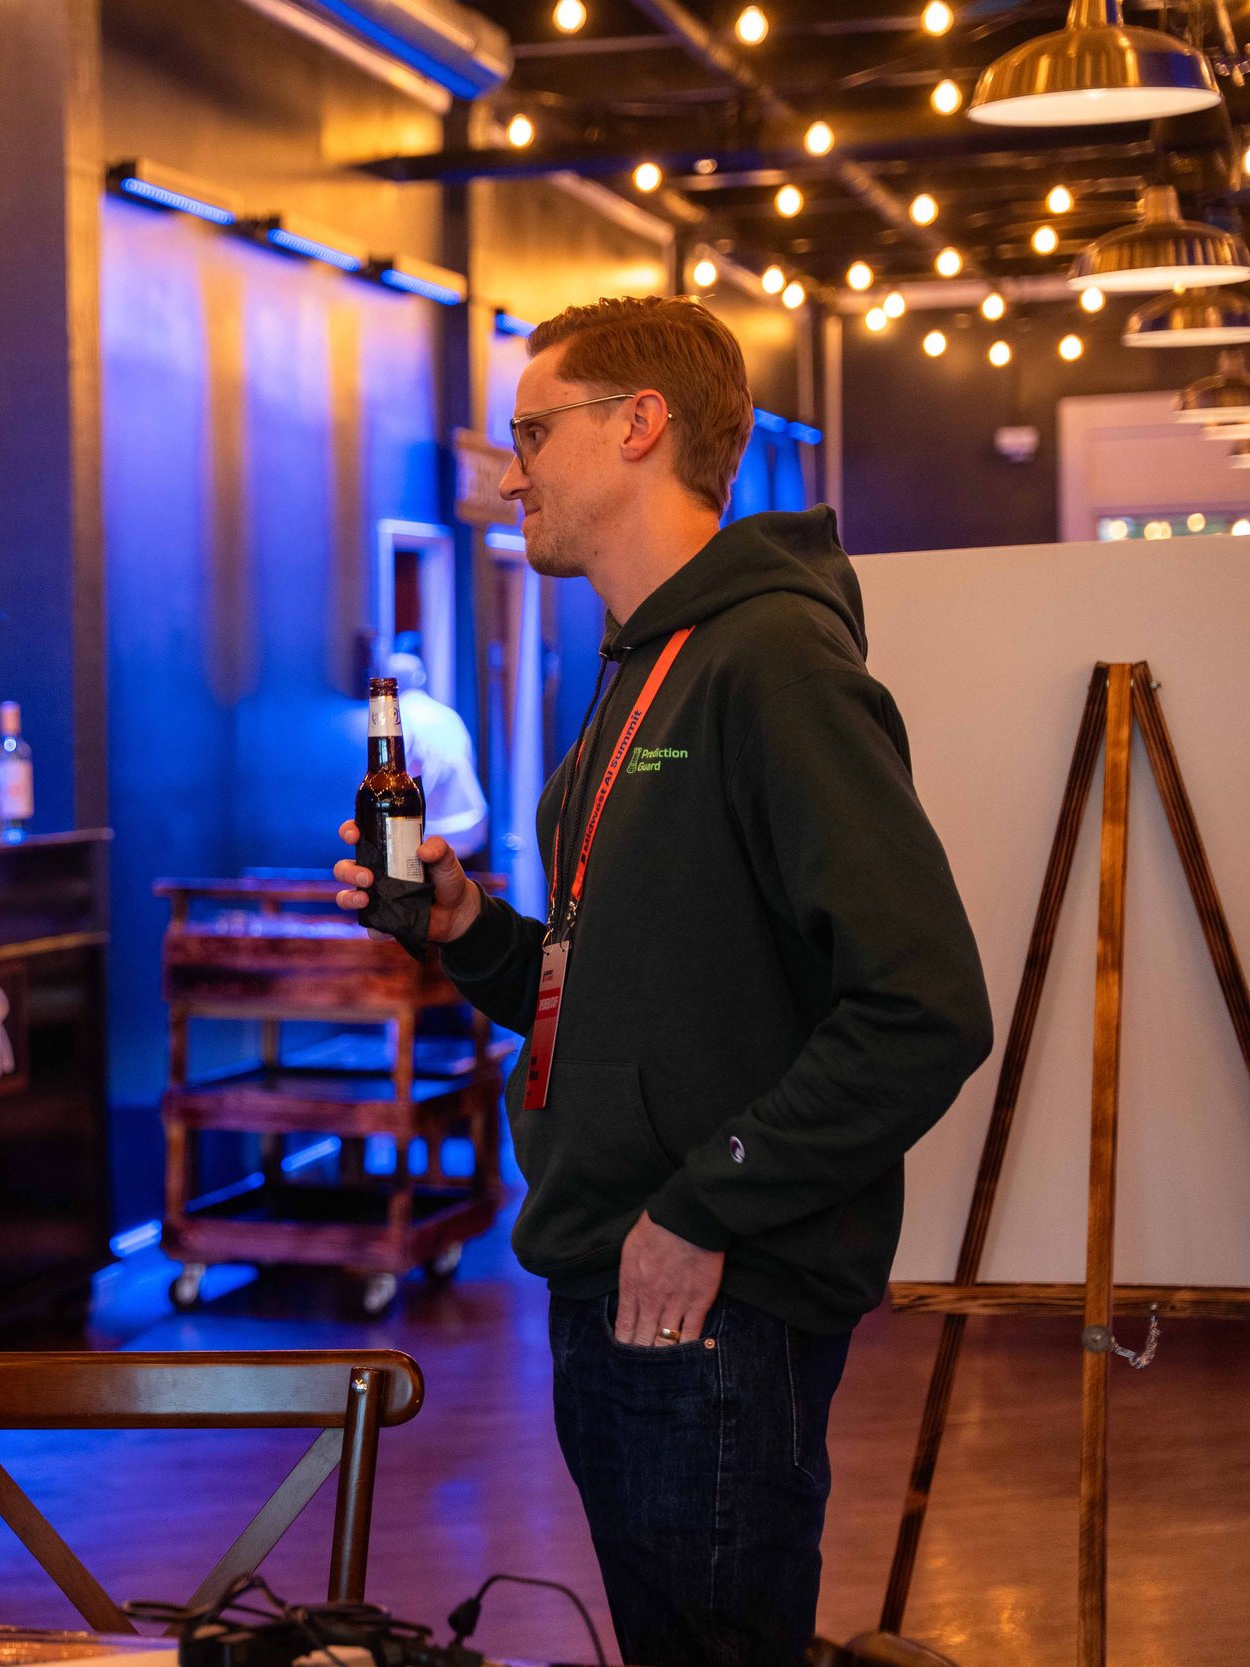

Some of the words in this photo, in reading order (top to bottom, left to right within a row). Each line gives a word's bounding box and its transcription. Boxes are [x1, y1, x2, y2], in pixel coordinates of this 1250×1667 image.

[641, 747, 689, 759] Prediction
[637, 761, 661, 772] Guard
[584, 787, 607, 851] Midwest
[604, 770, 614, 787] AI
[611, 709, 643, 769] Summit
